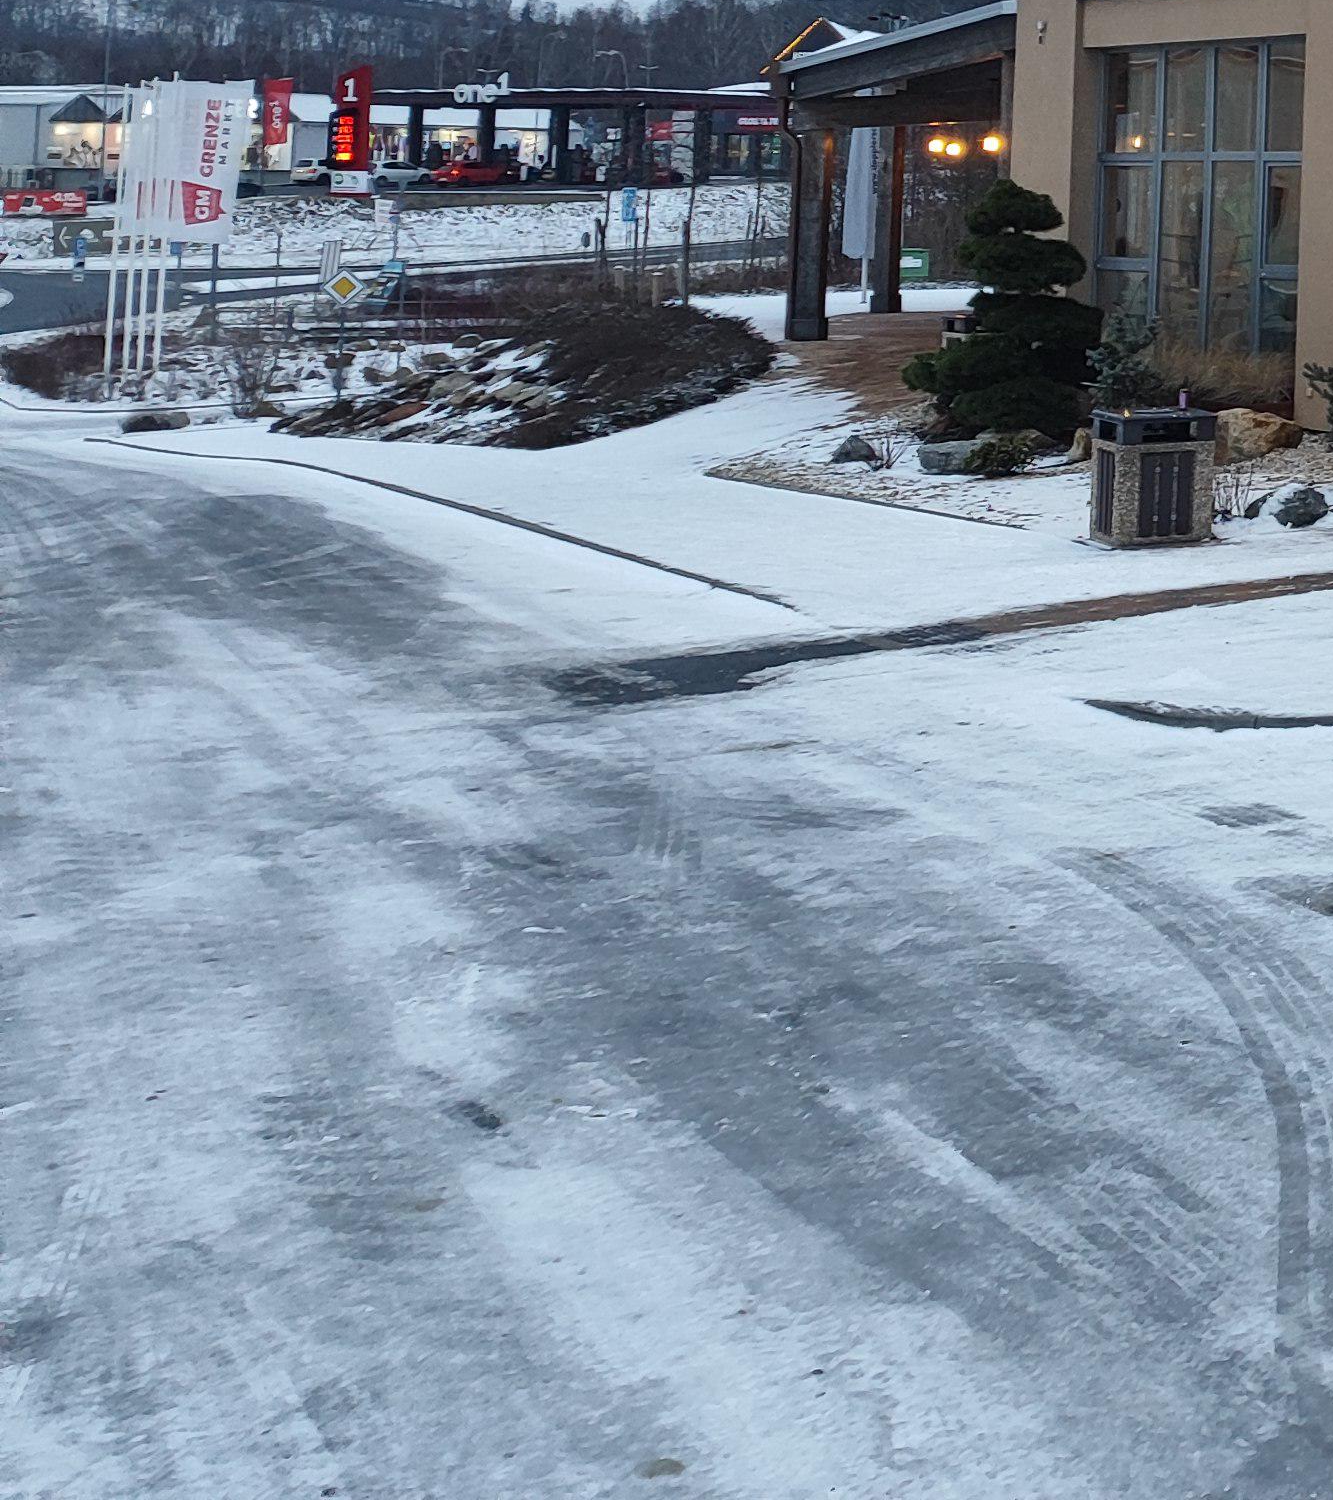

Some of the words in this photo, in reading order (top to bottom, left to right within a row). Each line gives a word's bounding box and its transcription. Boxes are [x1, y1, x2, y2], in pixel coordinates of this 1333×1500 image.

[200, 98, 223, 178] GRENZE
[218, 100, 236, 165] MARKT
[194, 189, 212, 221] GM
